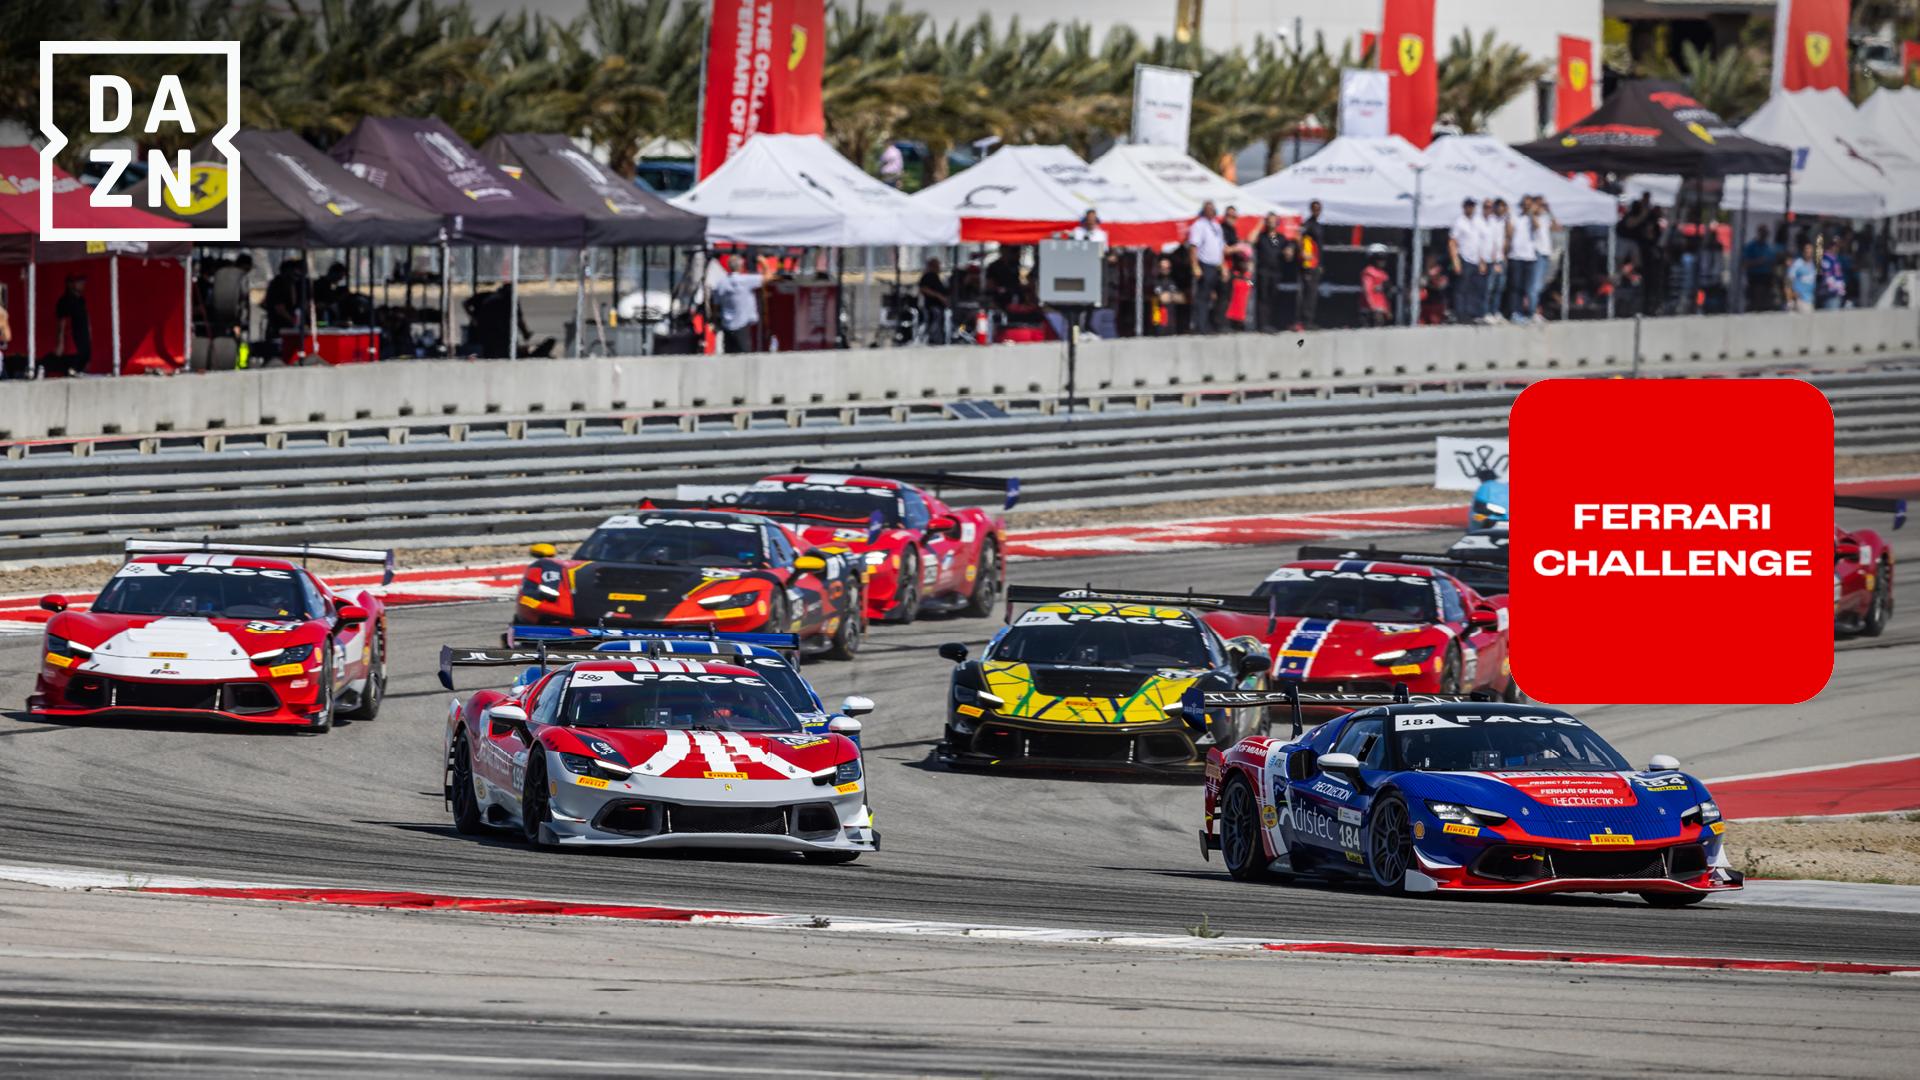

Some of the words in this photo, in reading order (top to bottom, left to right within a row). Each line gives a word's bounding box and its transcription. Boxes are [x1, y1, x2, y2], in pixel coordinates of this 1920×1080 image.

[756, 2, 772, 50] THE
[730, 98, 747, 132] OF
[577, 673, 603, 682] 199
[1402, 718, 1435, 726] 184
[1339, 824, 1361, 852] 184
